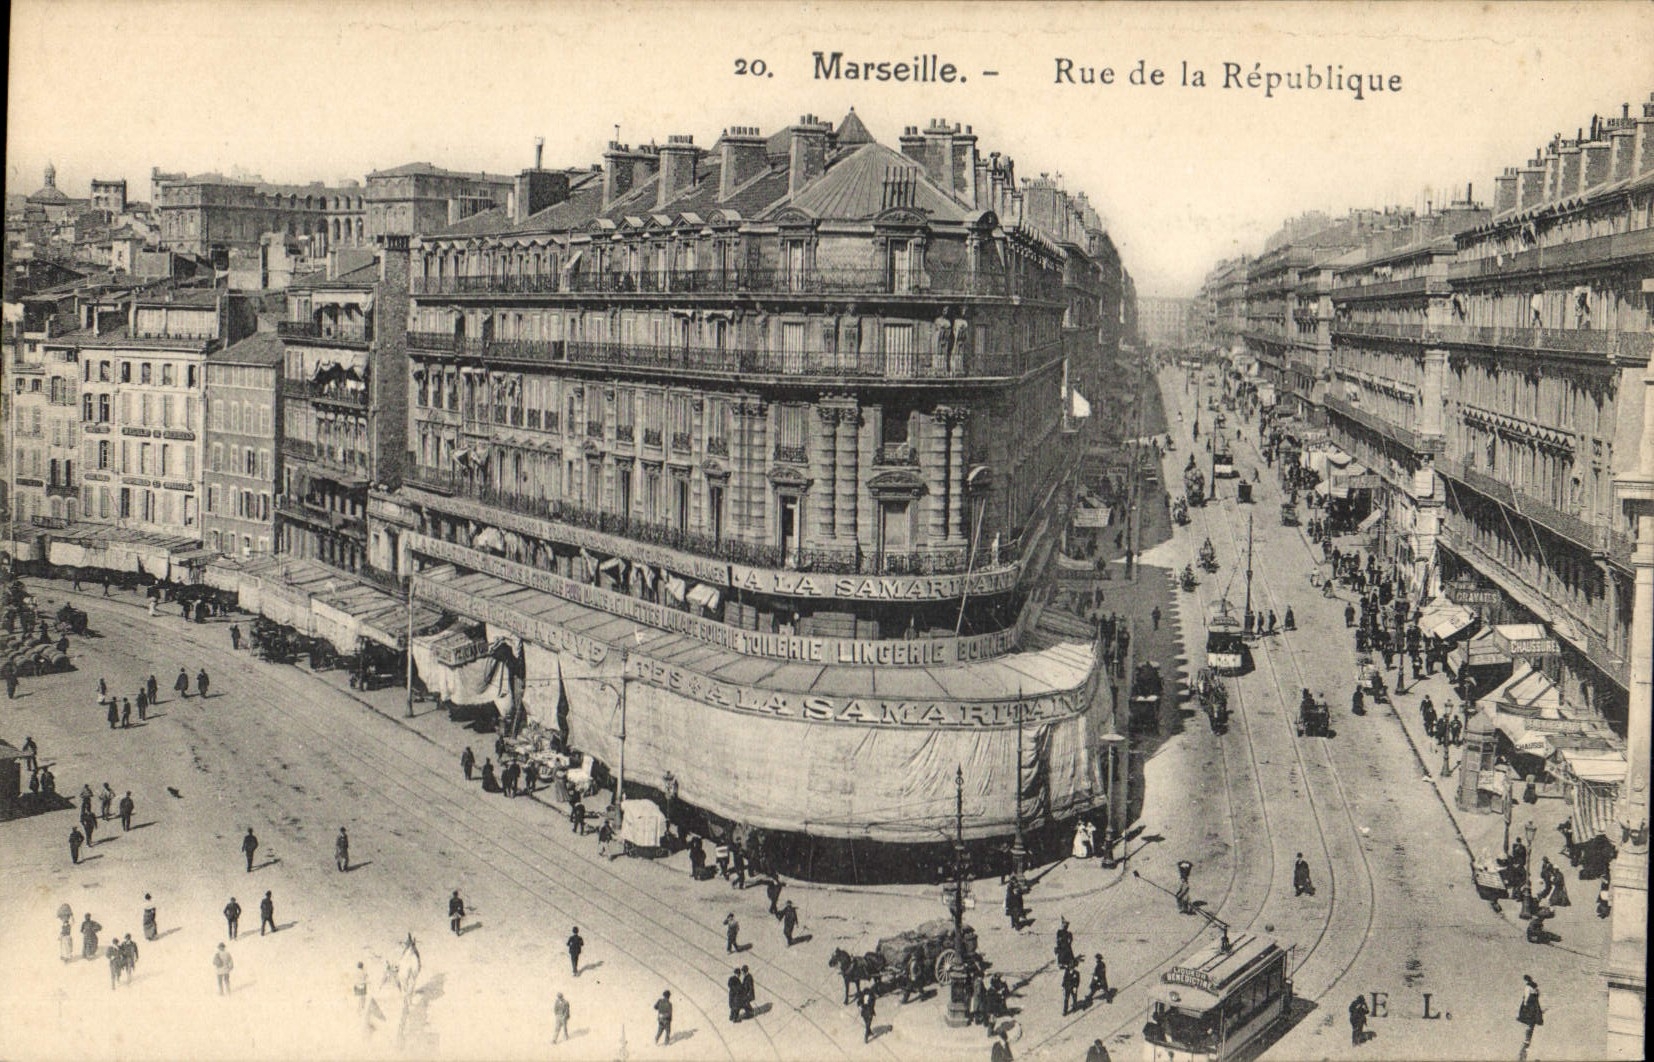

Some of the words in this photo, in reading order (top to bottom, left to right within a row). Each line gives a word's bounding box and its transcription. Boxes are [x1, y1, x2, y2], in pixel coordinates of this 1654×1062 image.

[742, 566, 762, 591] A
[774, 575, 821, 596] LA
[743, 634, 822, 662] TOILERIE
[838, 640, 945, 665] LINGERIE
[735, 687, 795, 716] LA
[802, 688, 1087, 727] SAMARITAINE
